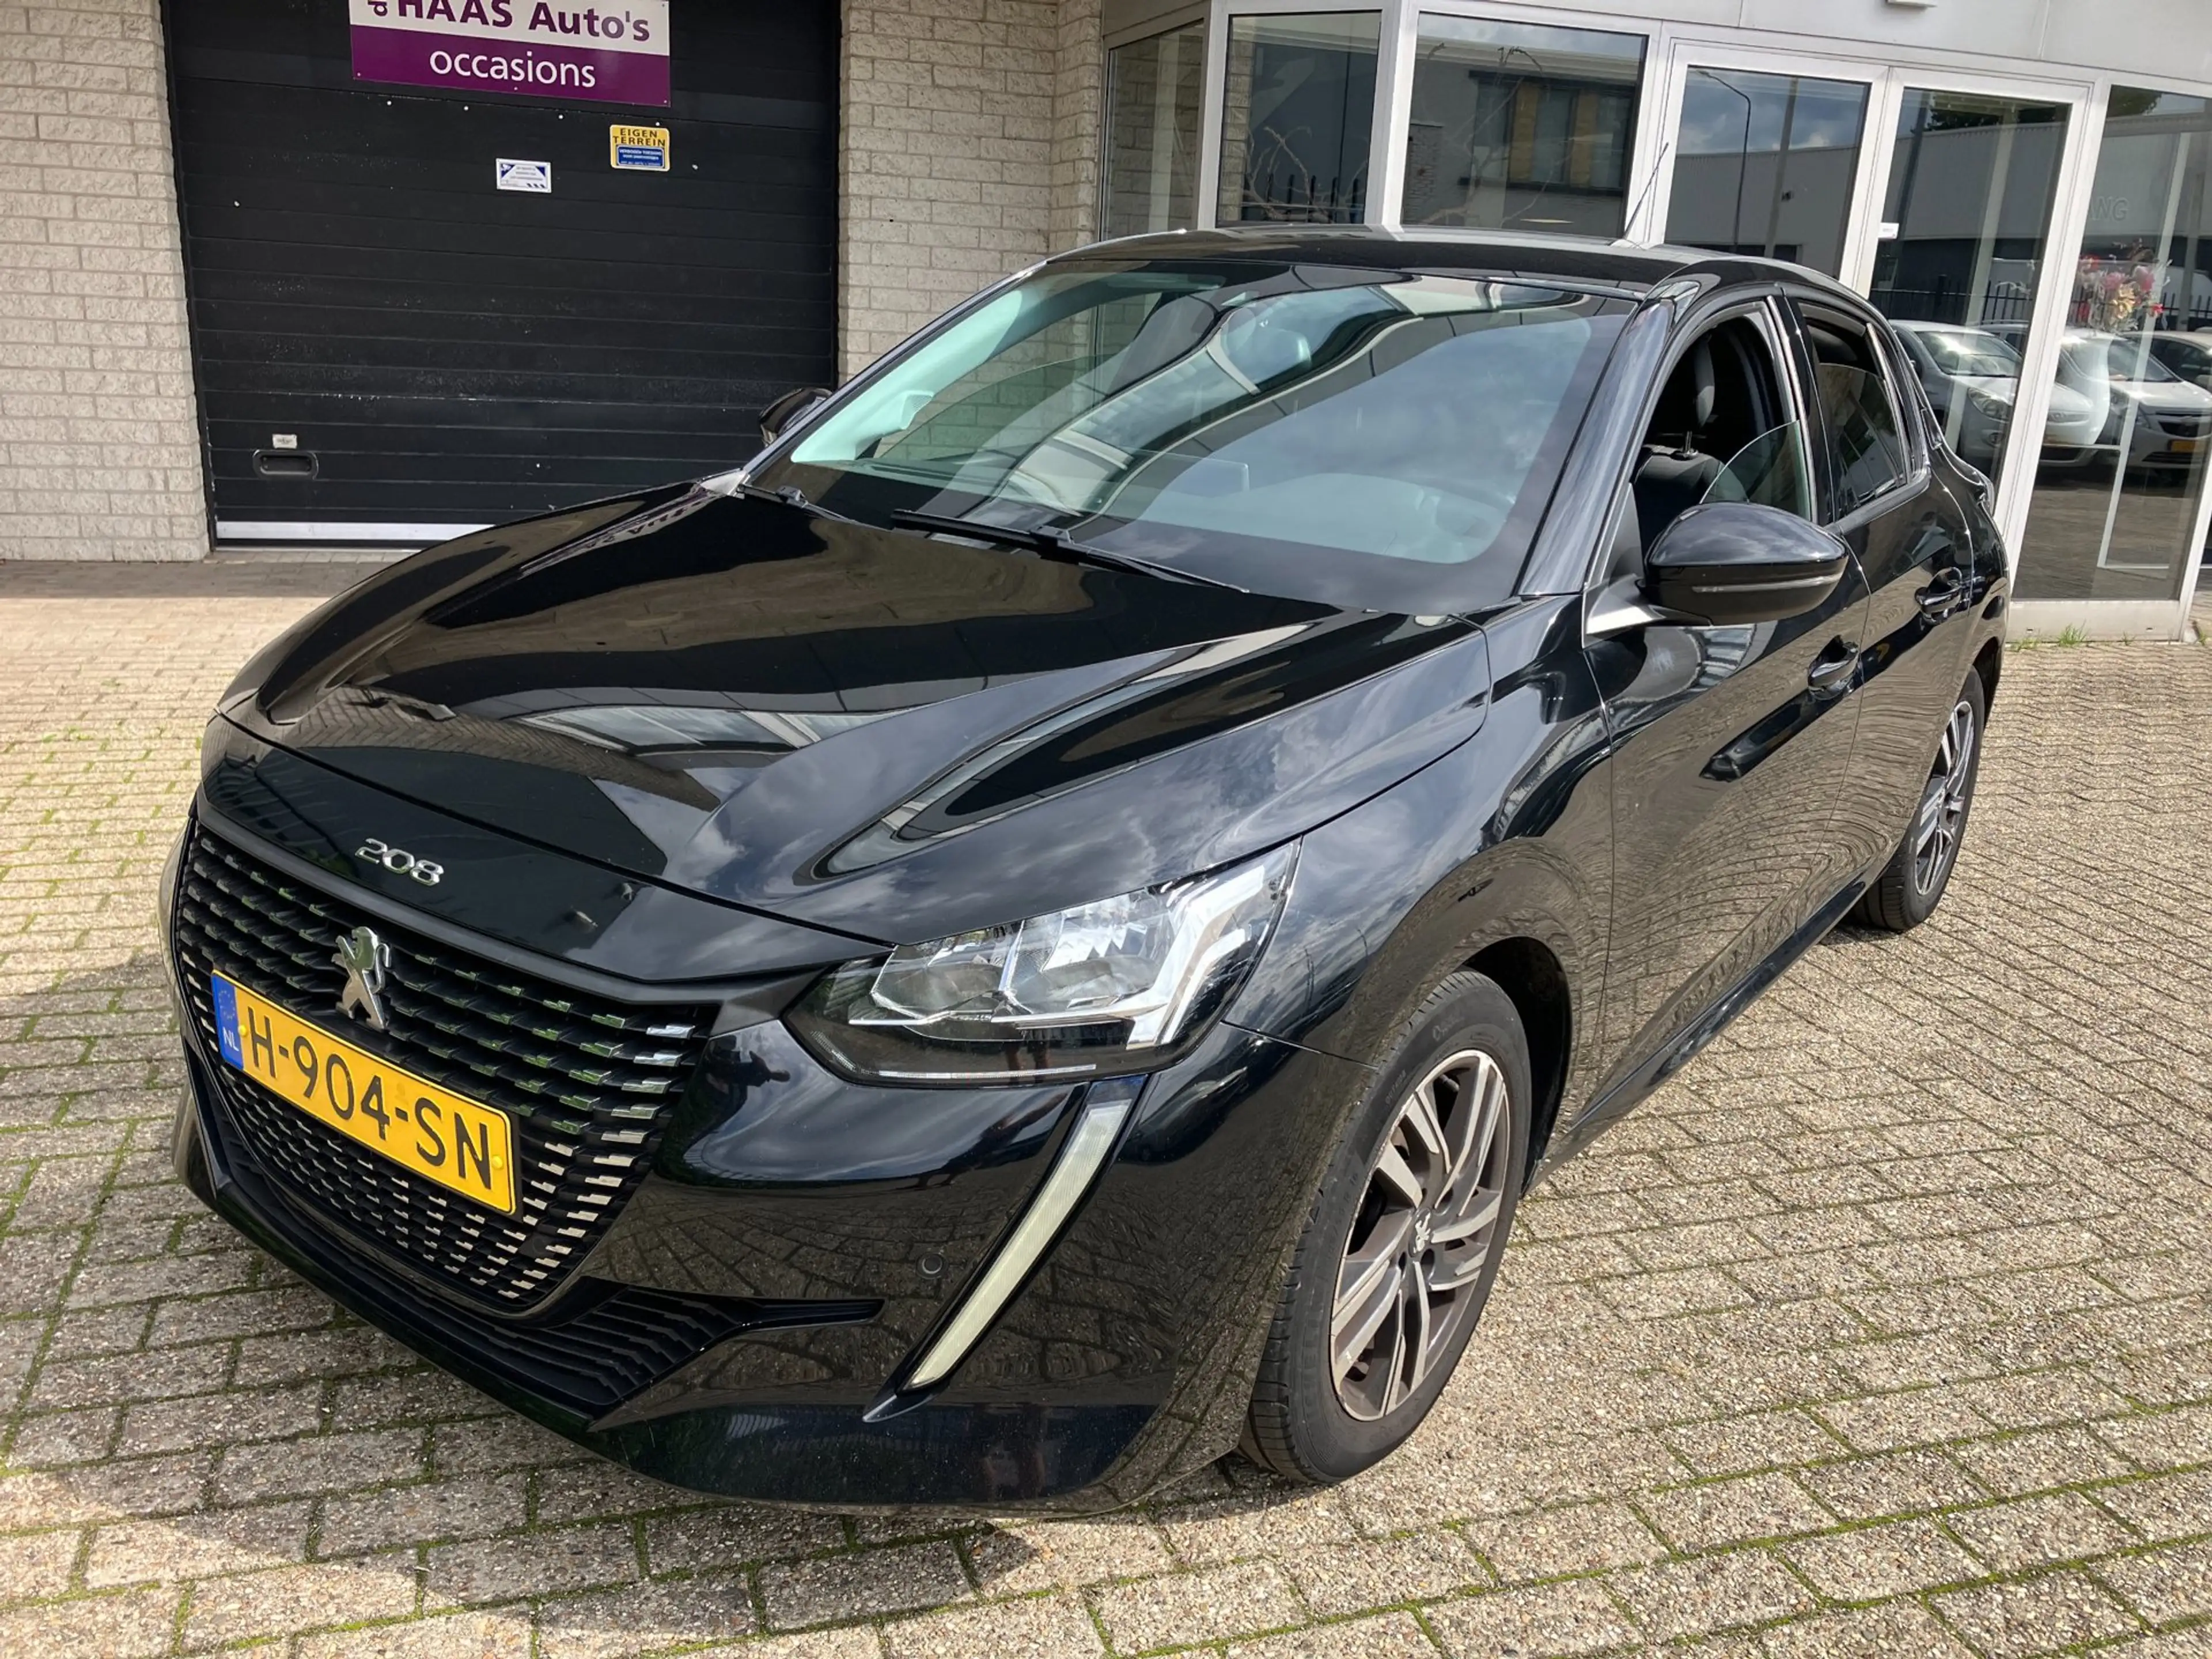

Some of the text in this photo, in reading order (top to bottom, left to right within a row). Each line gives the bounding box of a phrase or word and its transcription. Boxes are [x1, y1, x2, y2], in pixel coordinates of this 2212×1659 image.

[398, 0, 650, 41] HAAS Auto's
[430, 51, 596, 87] occasions
[612, 136, 666, 146] TERREIN
[620, 128, 658, 138] EIGEN
[354, 838, 444, 887] 208
[222, 1026, 240, 1052] NL
[248, 1006, 492, 1190] H-904-SN
